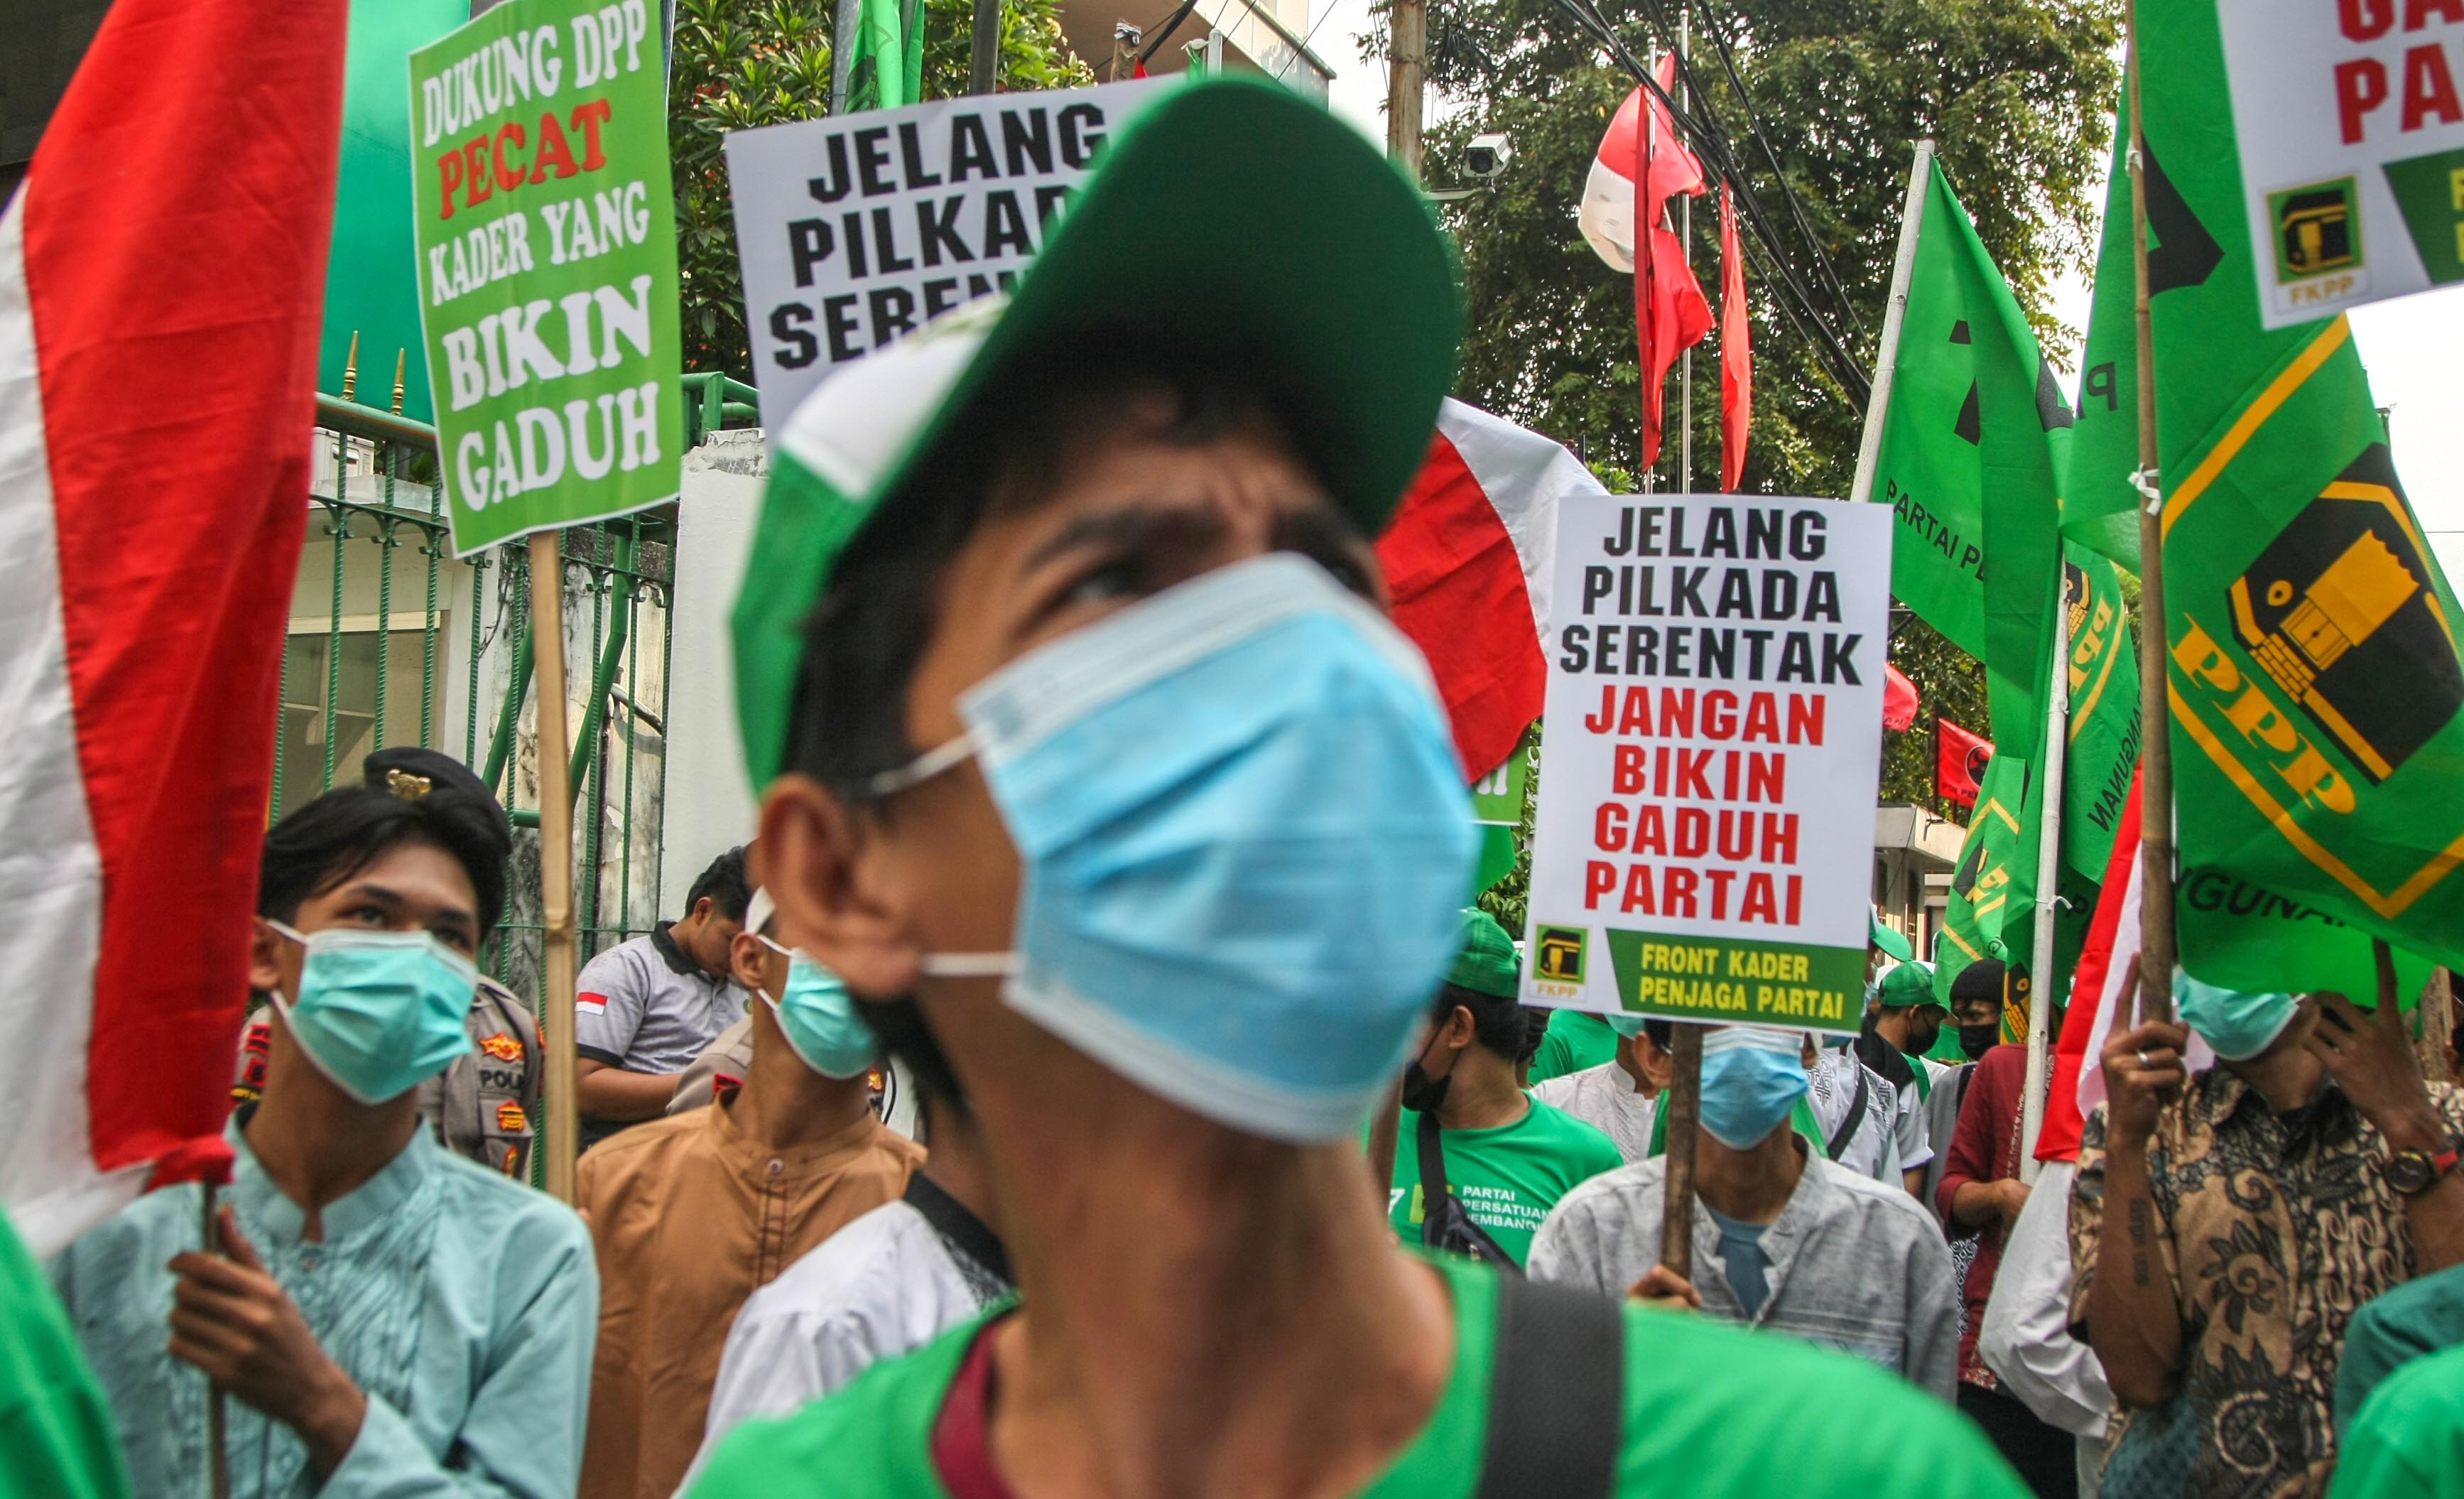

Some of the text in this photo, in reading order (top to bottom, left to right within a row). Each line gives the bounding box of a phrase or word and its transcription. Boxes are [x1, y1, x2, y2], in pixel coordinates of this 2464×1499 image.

[423, 0, 648, 148] DUKUNG DPP
[438, 99, 611, 220] PECAT
[808, 103, 1107, 204] JELANG
[429, 181, 649, 306] KADER YANG
[769, 271, 1024, 370] SERE
[2289, 277, 2355, 305] FKPP
[443, 274, 653, 412] BIKIN
[456, 381, 661, 512] GADUH
[1603, 507, 1826, 561] JELANG
[1886, 477, 1959, 559] PARTAI
[1583, 565, 1842, 623] PILKADA
[1561, 624, 1862, 686] SERENTAK
[1585, 685, 1825, 746] JANGAN
[2169, 612, 2356, 814] PPP
[1613, 745, 1786, 804] BIKIN
[1595, 802, 1799, 865] GADUH
[1585, 860, 1802, 926] PARTAI
[1537, 984, 1578, 998] FKPP
[1641, 943, 1808, 983] FRONT KADER
[1639, 977, 1843, 1019] PENJAGA PARTAI
[1462, 1186, 1515, 1201] PARTAI
[1467, 1213, 1541, 1232] EMBANG
